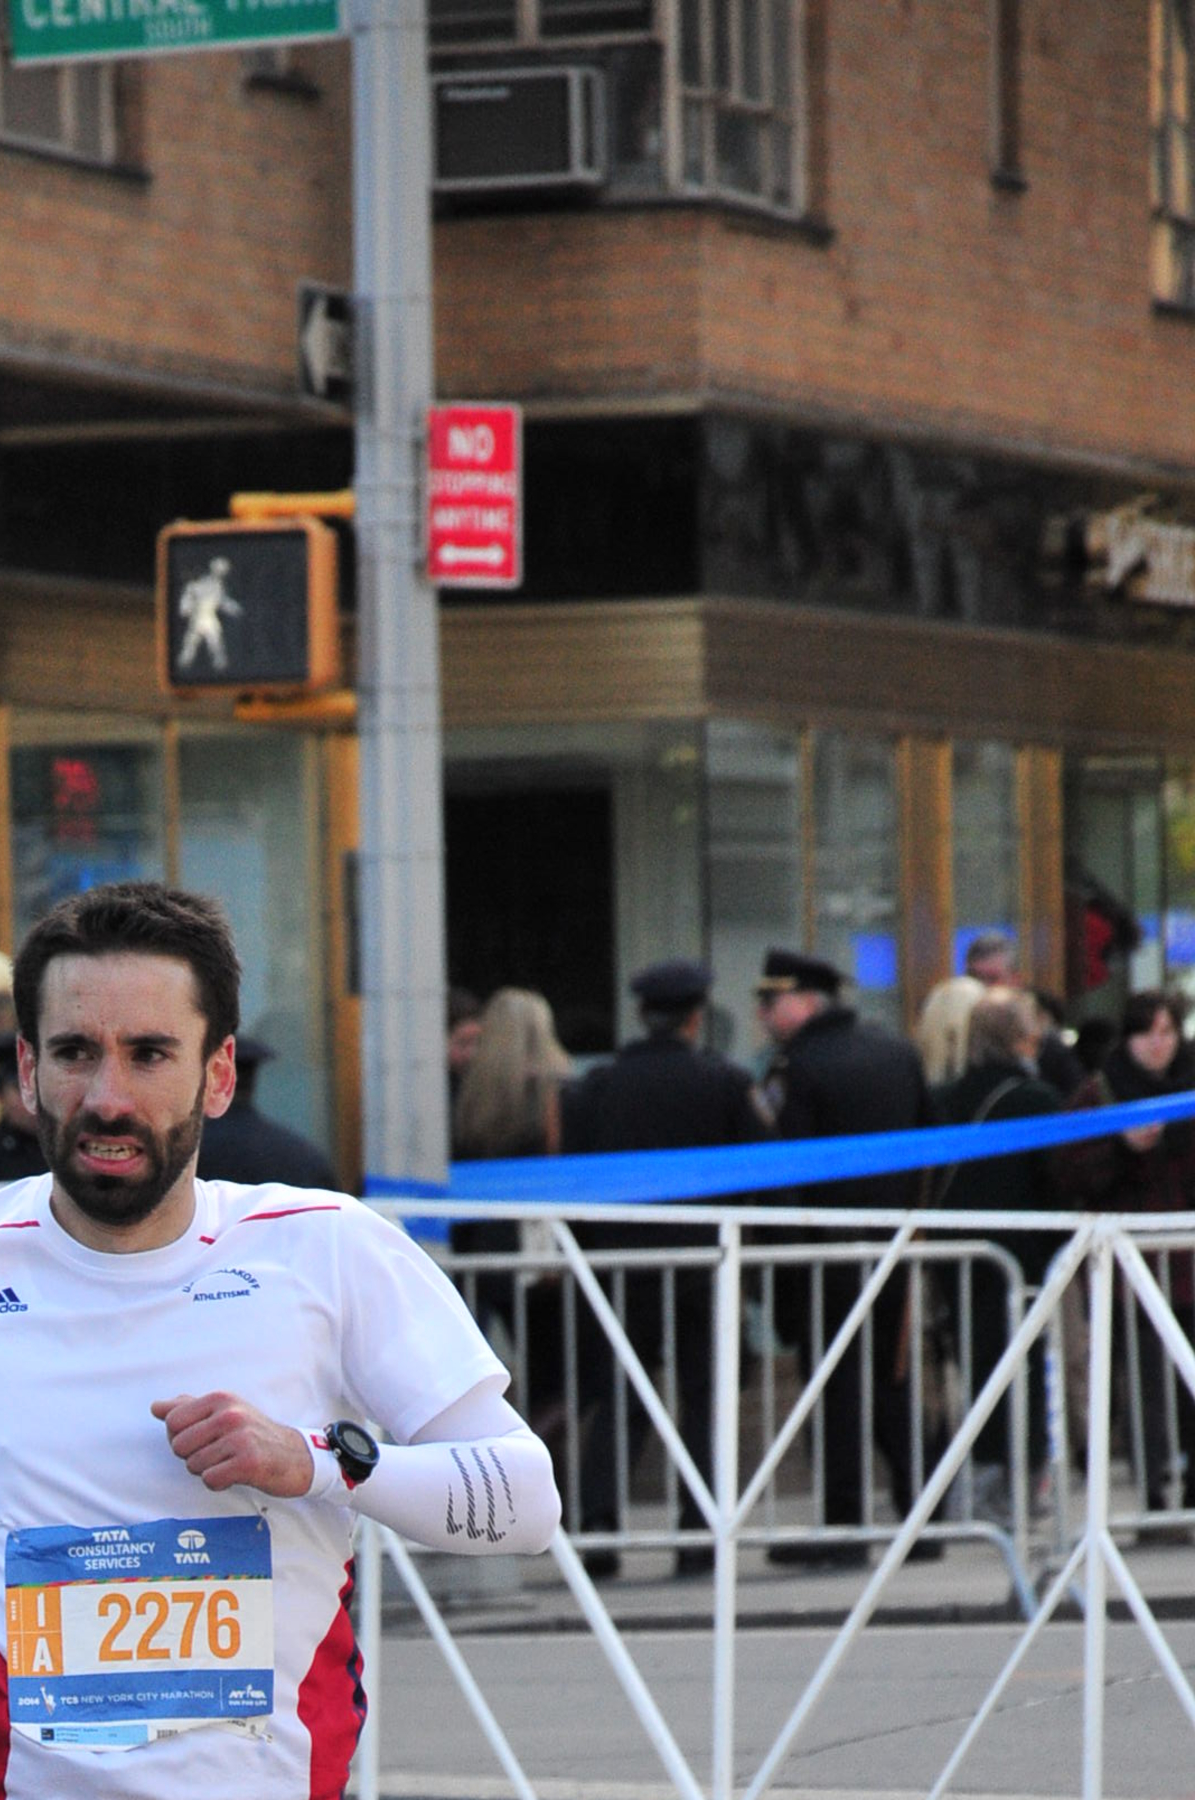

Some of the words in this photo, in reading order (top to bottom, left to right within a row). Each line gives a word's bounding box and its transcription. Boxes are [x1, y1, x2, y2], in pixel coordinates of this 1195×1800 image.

[447, 423, 496, 462] NO
[92, 1530, 130, 1542] TATA
[68, 1542, 155, 1558] CONSULTANCY
[84, 1556, 140, 1570] SERVICES
[174, 1552, 211, 1564] TATA
[98, 1590, 241, 1662] 2276
[32, 1637, 53, 1672] A
[81, 1695, 104, 1704] NEW
[108, 1693, 134, 1702] YORK
[136, 1692, 158, 1701] CITY
[160, 1690, 214, 1700] MARATHON
